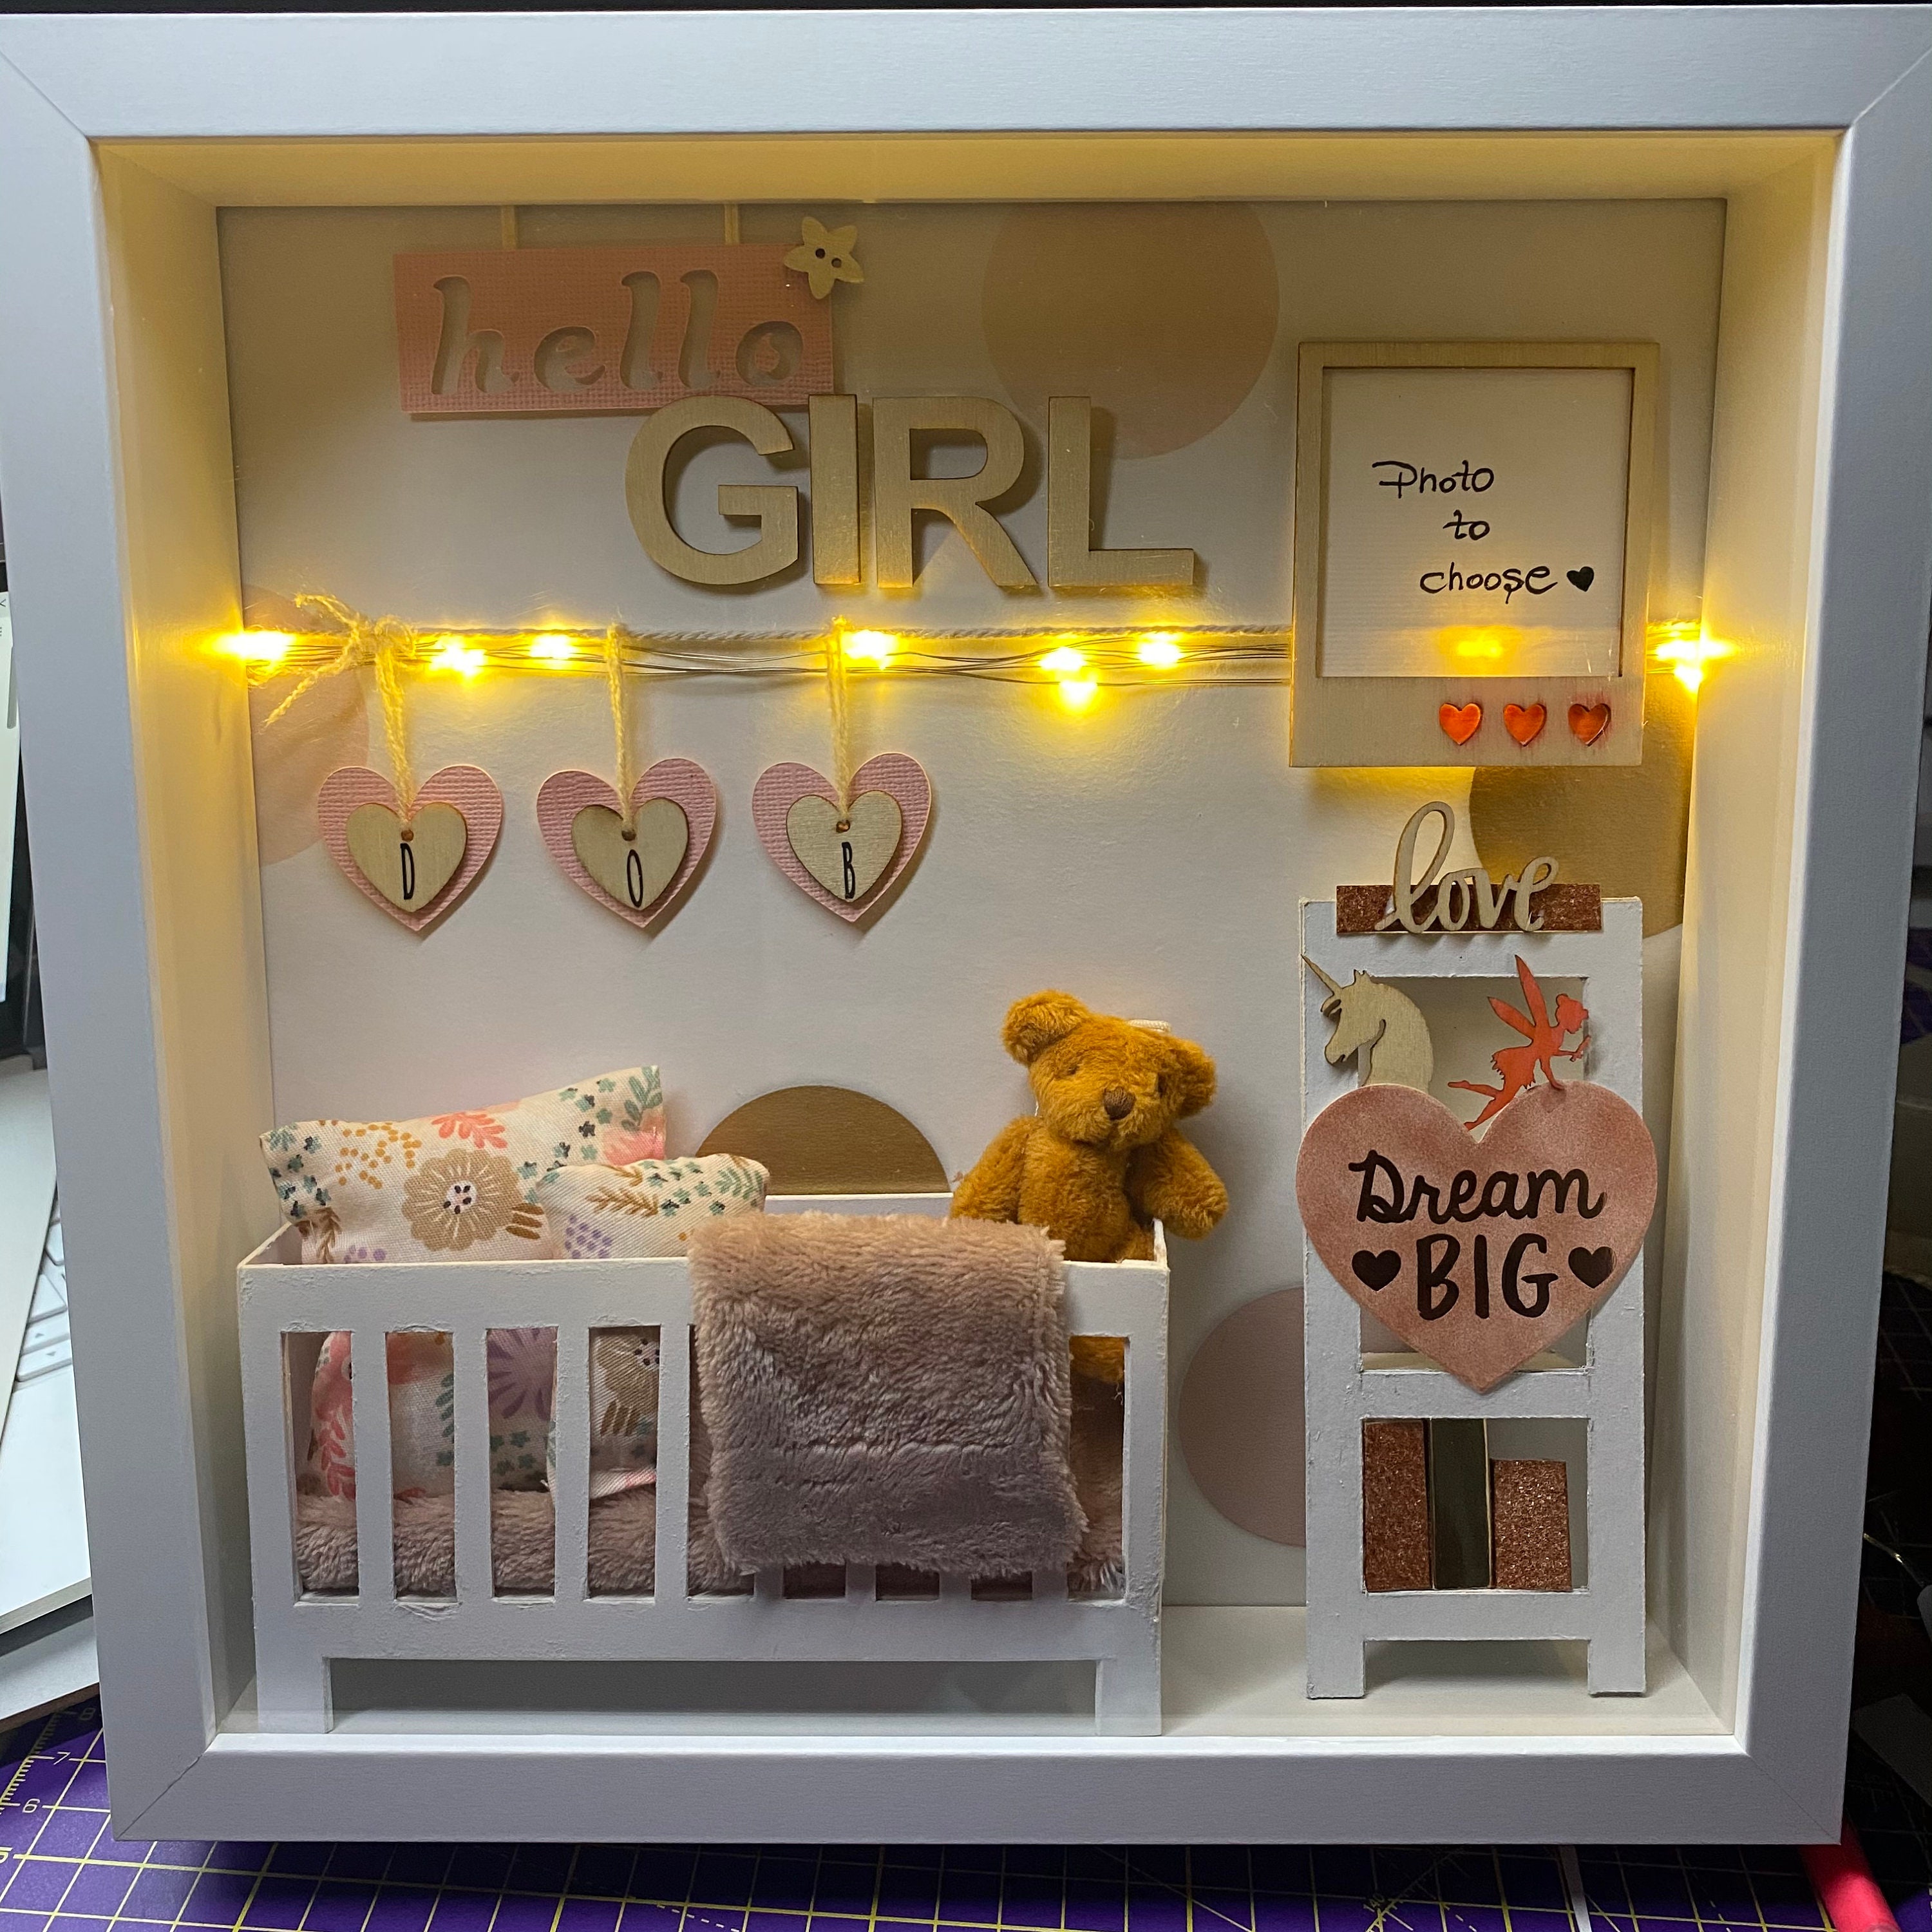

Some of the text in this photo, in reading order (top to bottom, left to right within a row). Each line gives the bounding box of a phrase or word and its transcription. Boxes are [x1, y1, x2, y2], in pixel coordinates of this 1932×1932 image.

[431, 269, 804, 395] hello
[625, 393, 1194, 589] GIRL
[1372, 460, 1495, 499] Photo
[1443, 509, 1490, 540] to
[1419, 562, 1558, 604] choose
[400, 843, 415, 900] D
[842, 842, 856, 899] B
[1374, 800, 1559, 934] love
[1348, 1150, 1607, 1224] Dream
[1416, 1233, 1558, 1321] BIG
[53, 1751, 71, 1765] 7
[22, 1798, 41, 1814] 6
